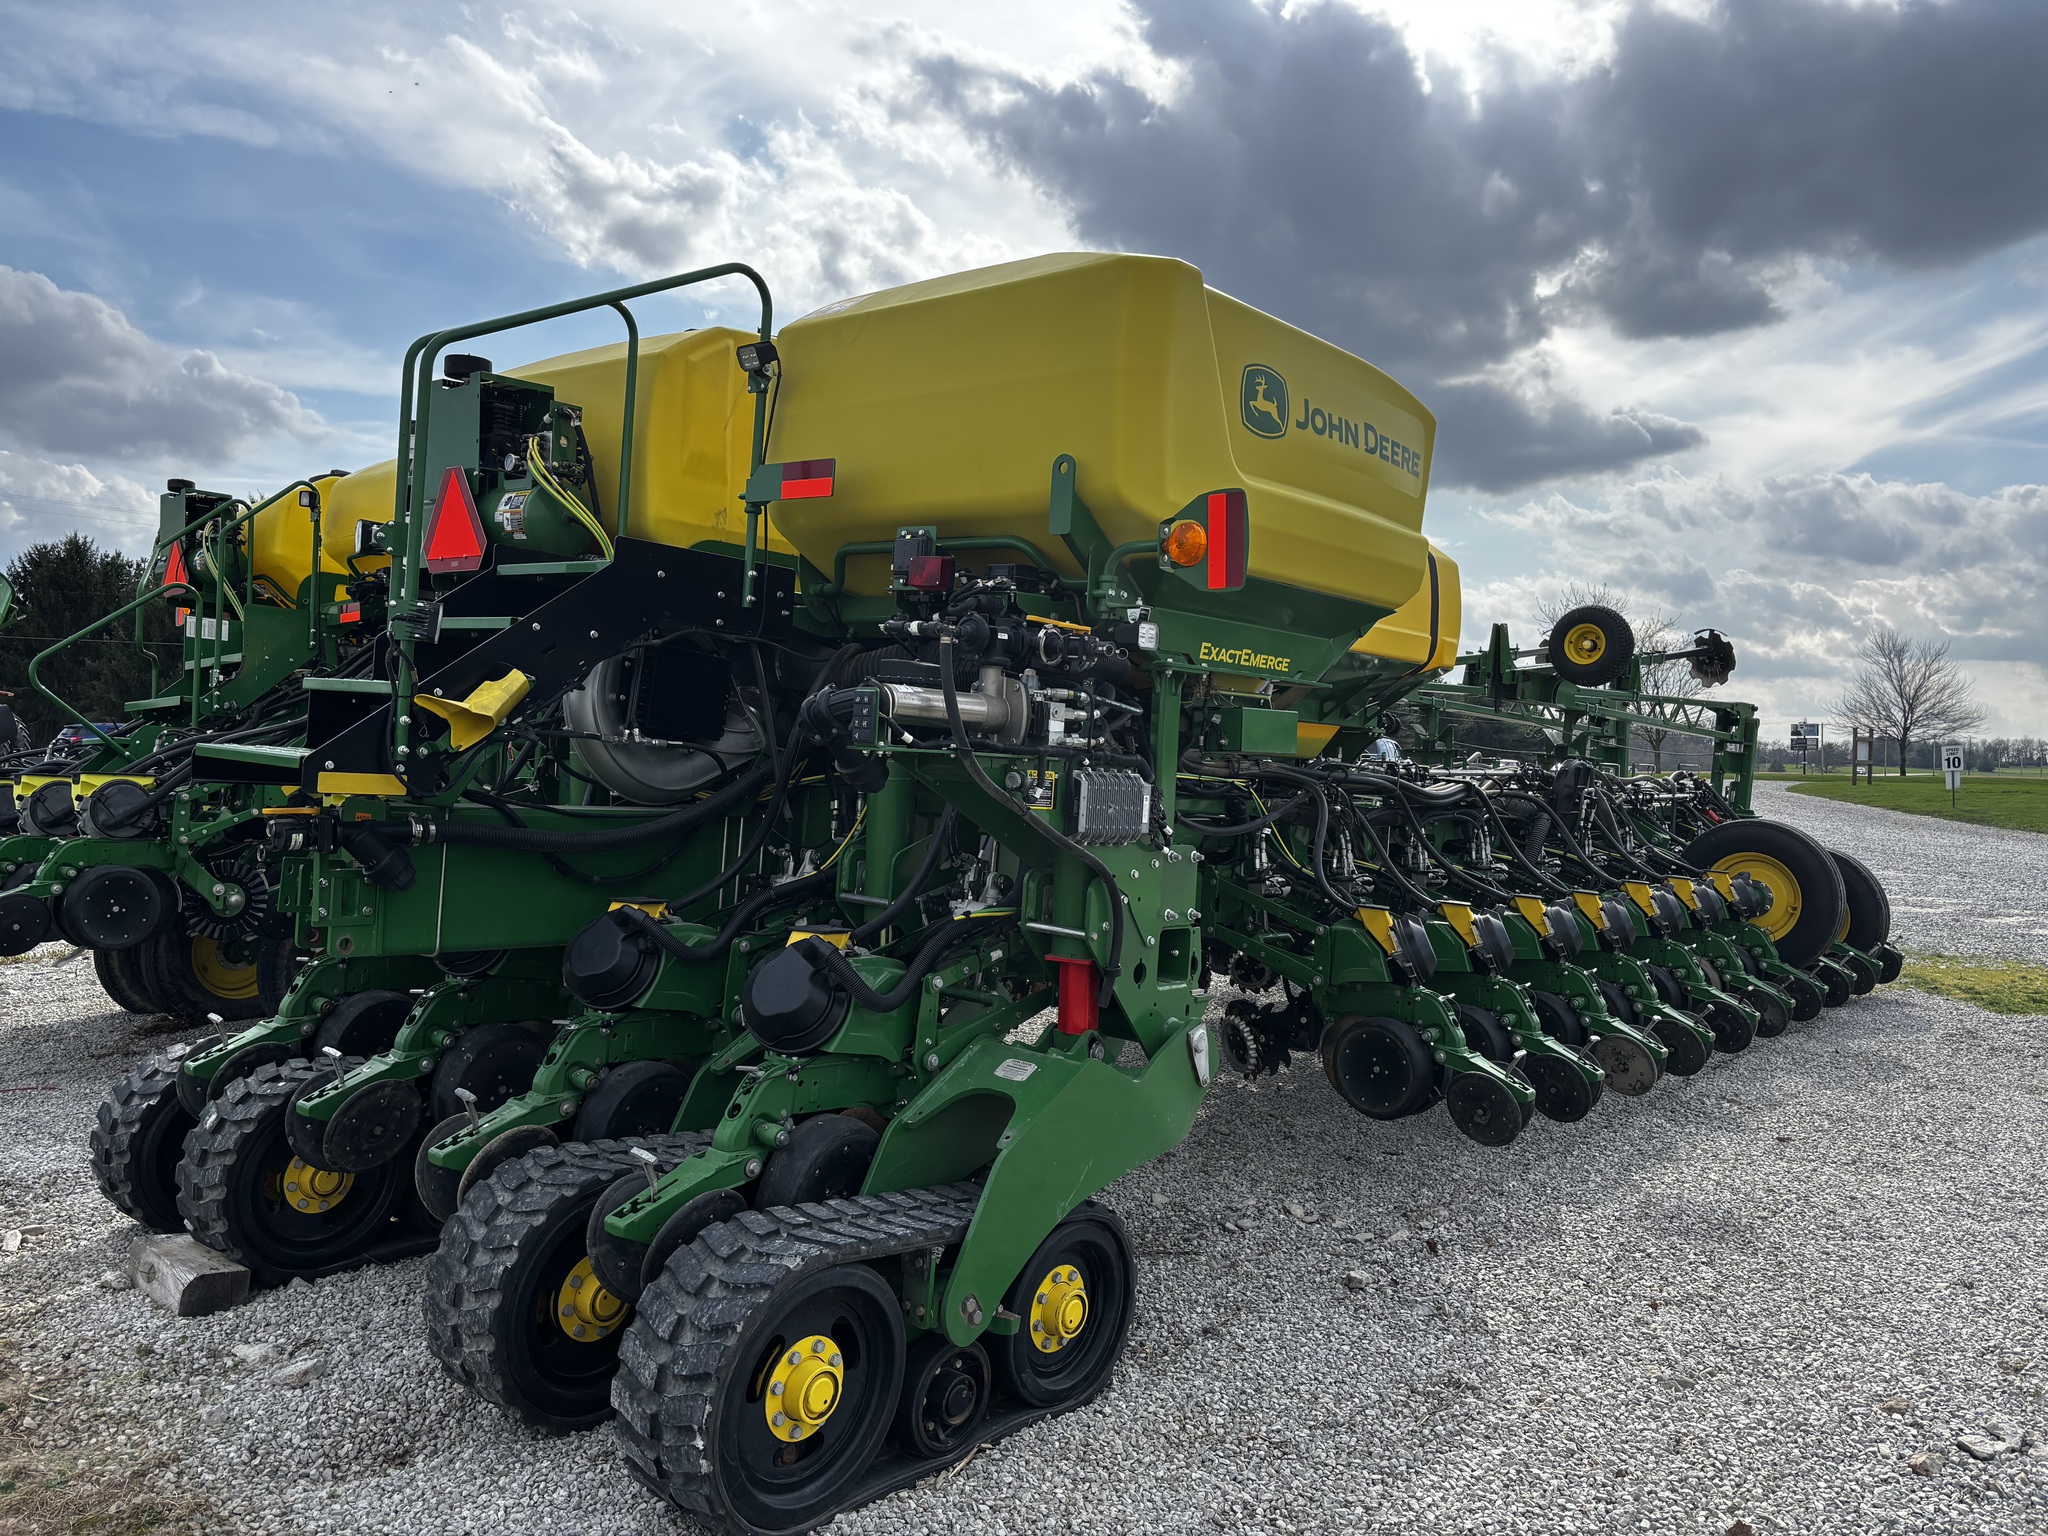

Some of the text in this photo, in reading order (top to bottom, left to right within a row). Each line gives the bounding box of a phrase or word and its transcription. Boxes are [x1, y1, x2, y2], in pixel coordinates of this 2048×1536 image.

[1296, 398, 1421, 479] JOHN DEERE
[1945, 757, 1961, 768] 10
